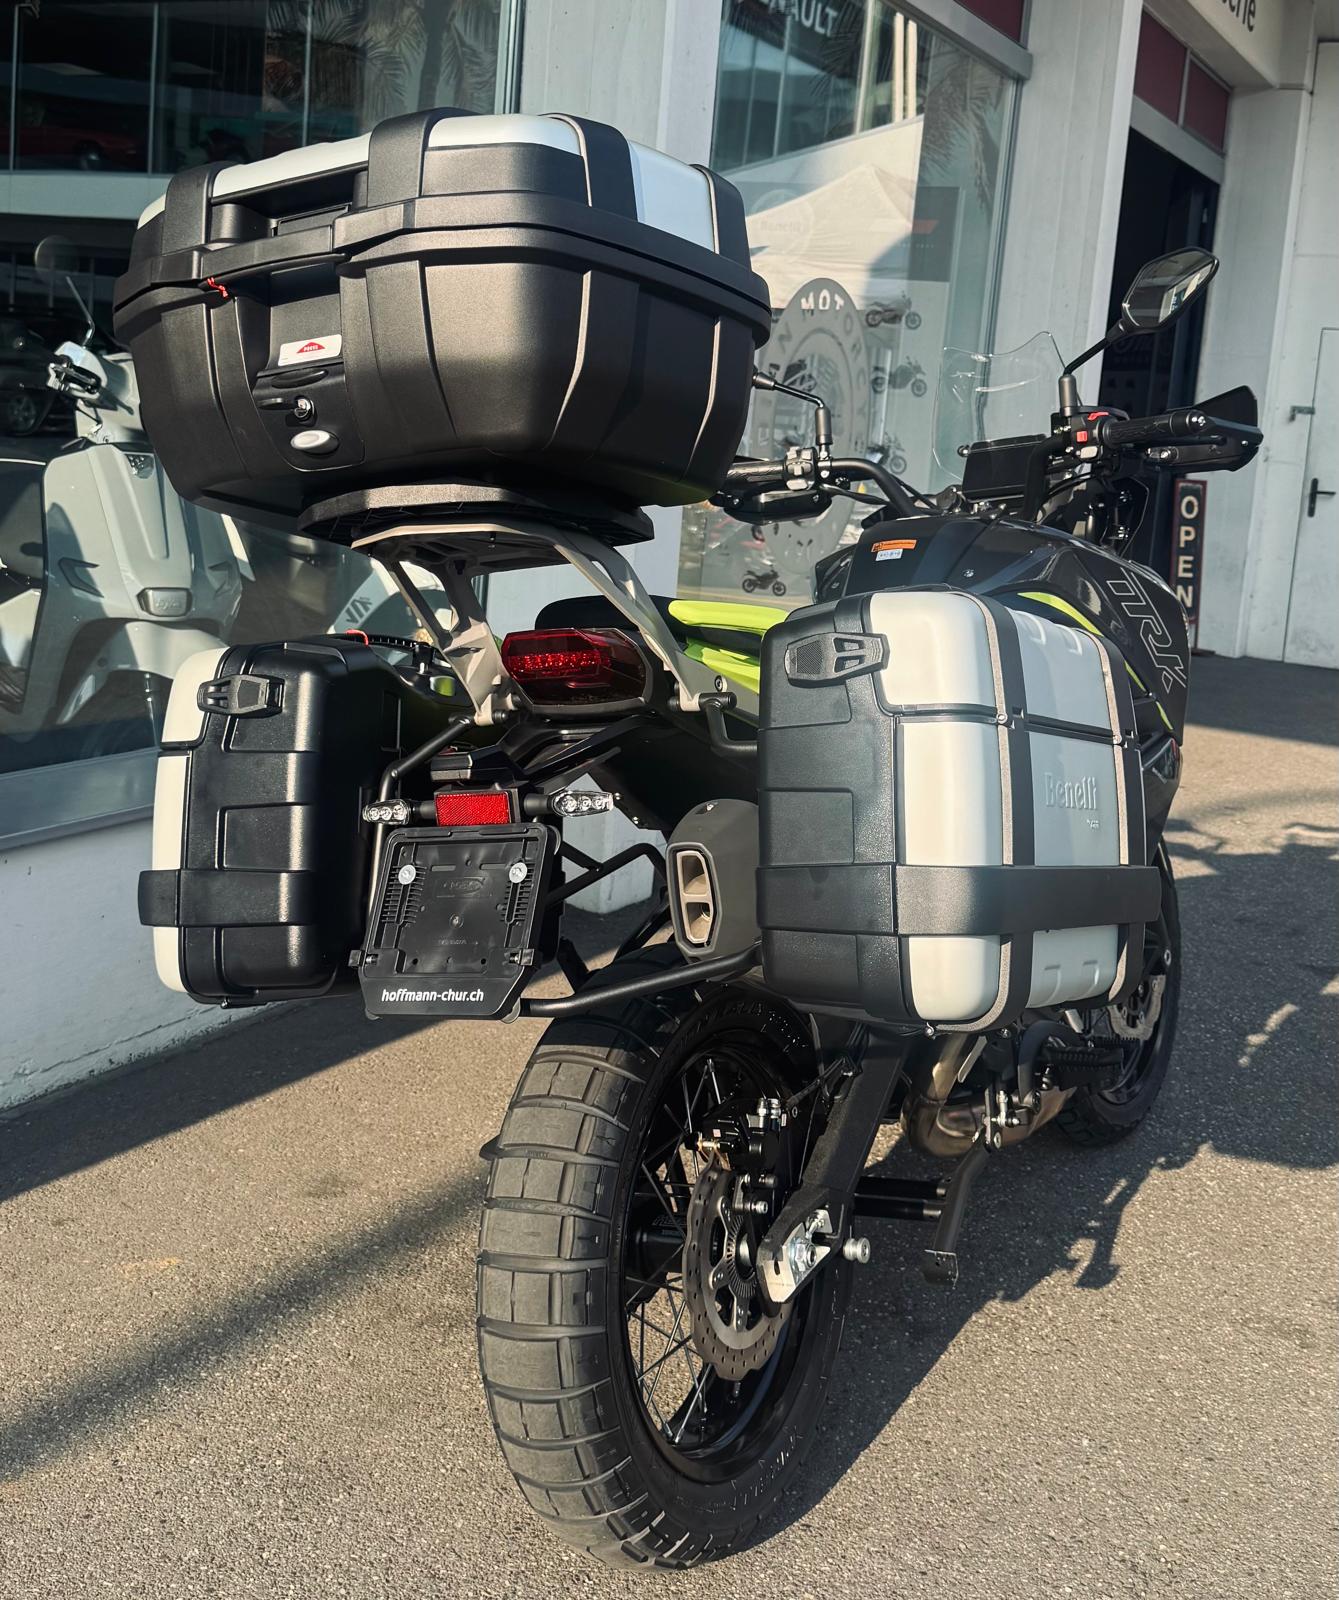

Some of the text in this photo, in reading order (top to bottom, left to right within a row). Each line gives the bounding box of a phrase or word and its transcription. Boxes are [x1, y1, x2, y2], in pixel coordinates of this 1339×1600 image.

[1176, 495, 1199, 608] OPEN
[1044, 772, 1097, 810] Benelli
[381, 988, 484, 1002] hoffmann-chur.ch
